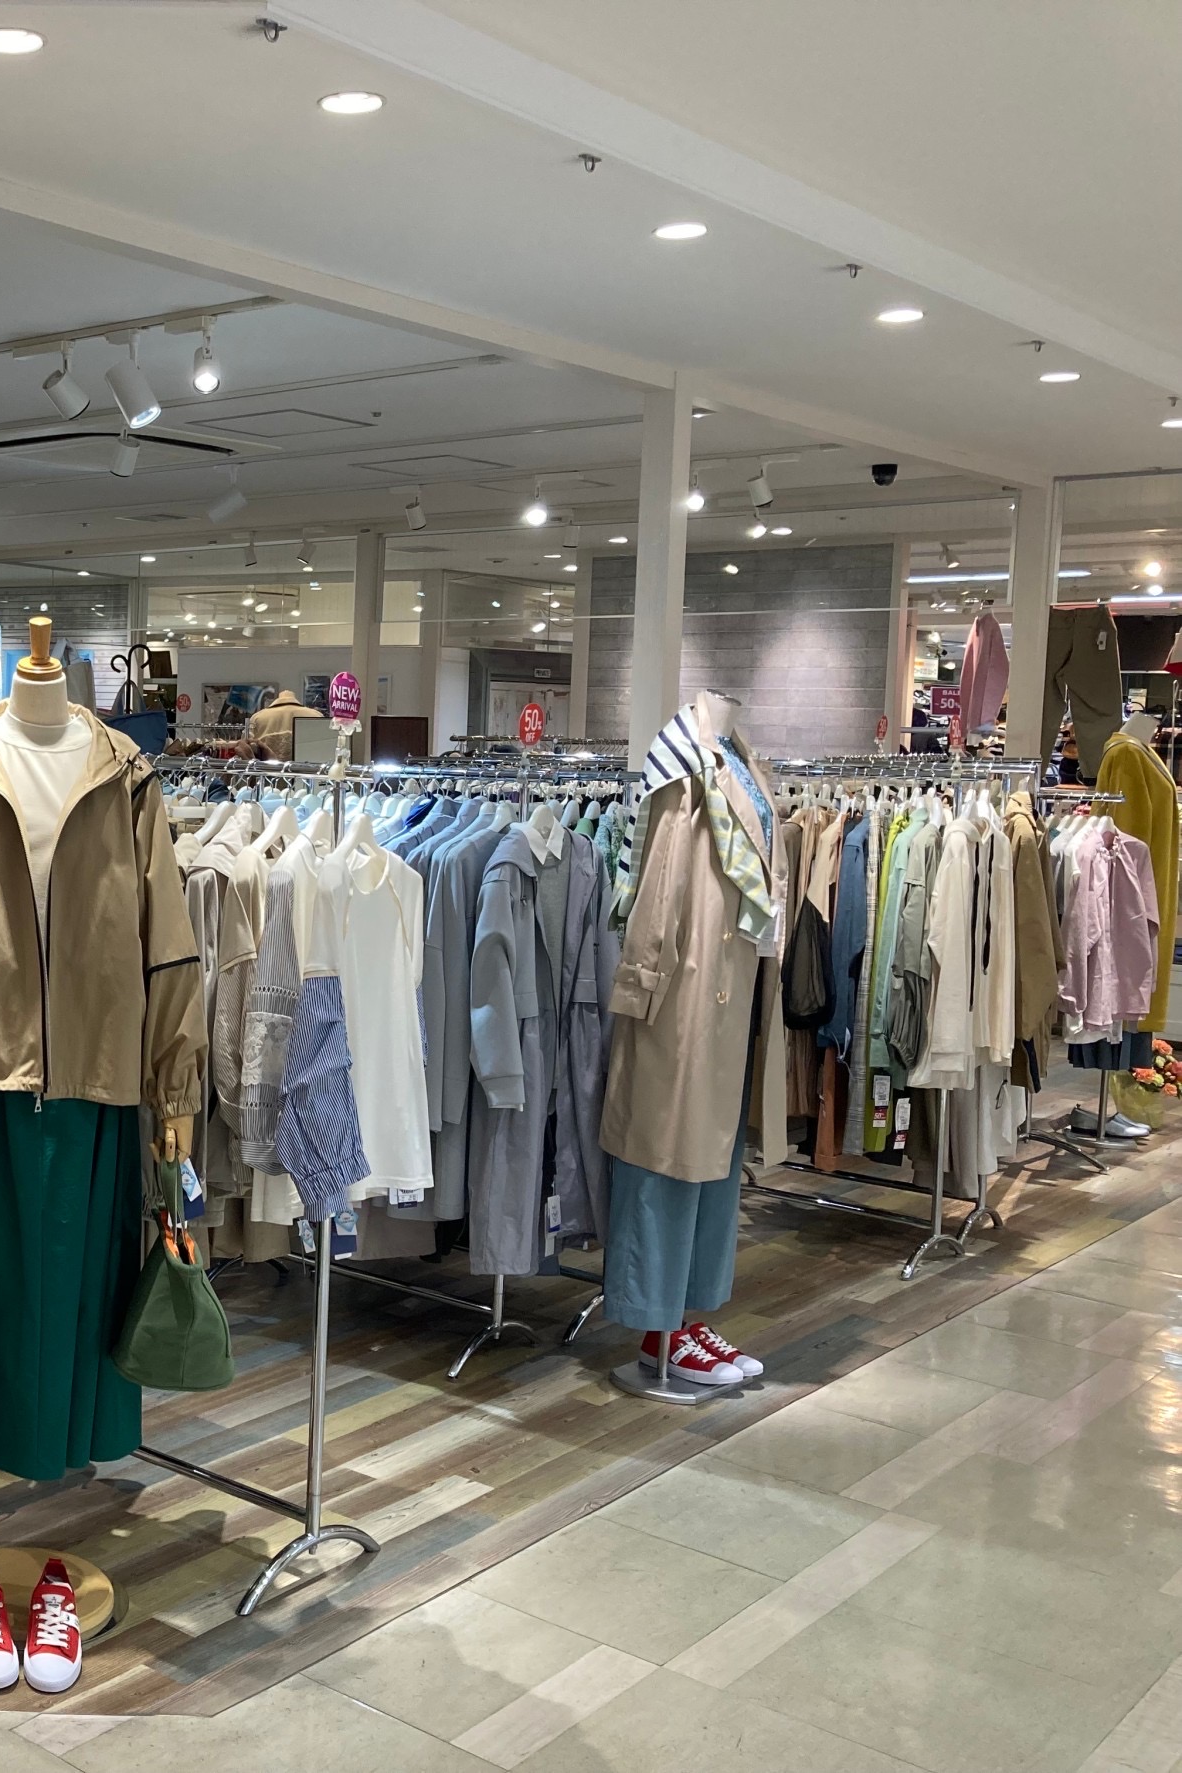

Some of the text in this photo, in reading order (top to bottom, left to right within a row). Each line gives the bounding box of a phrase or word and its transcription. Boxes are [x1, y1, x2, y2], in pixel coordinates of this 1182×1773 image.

[332, 684, 359, 702] NEW
[331, 699, 358, 713] ARRIVAL
[524, 709, 542, 732] 50%
[525, 732, 536, 743] OFF
